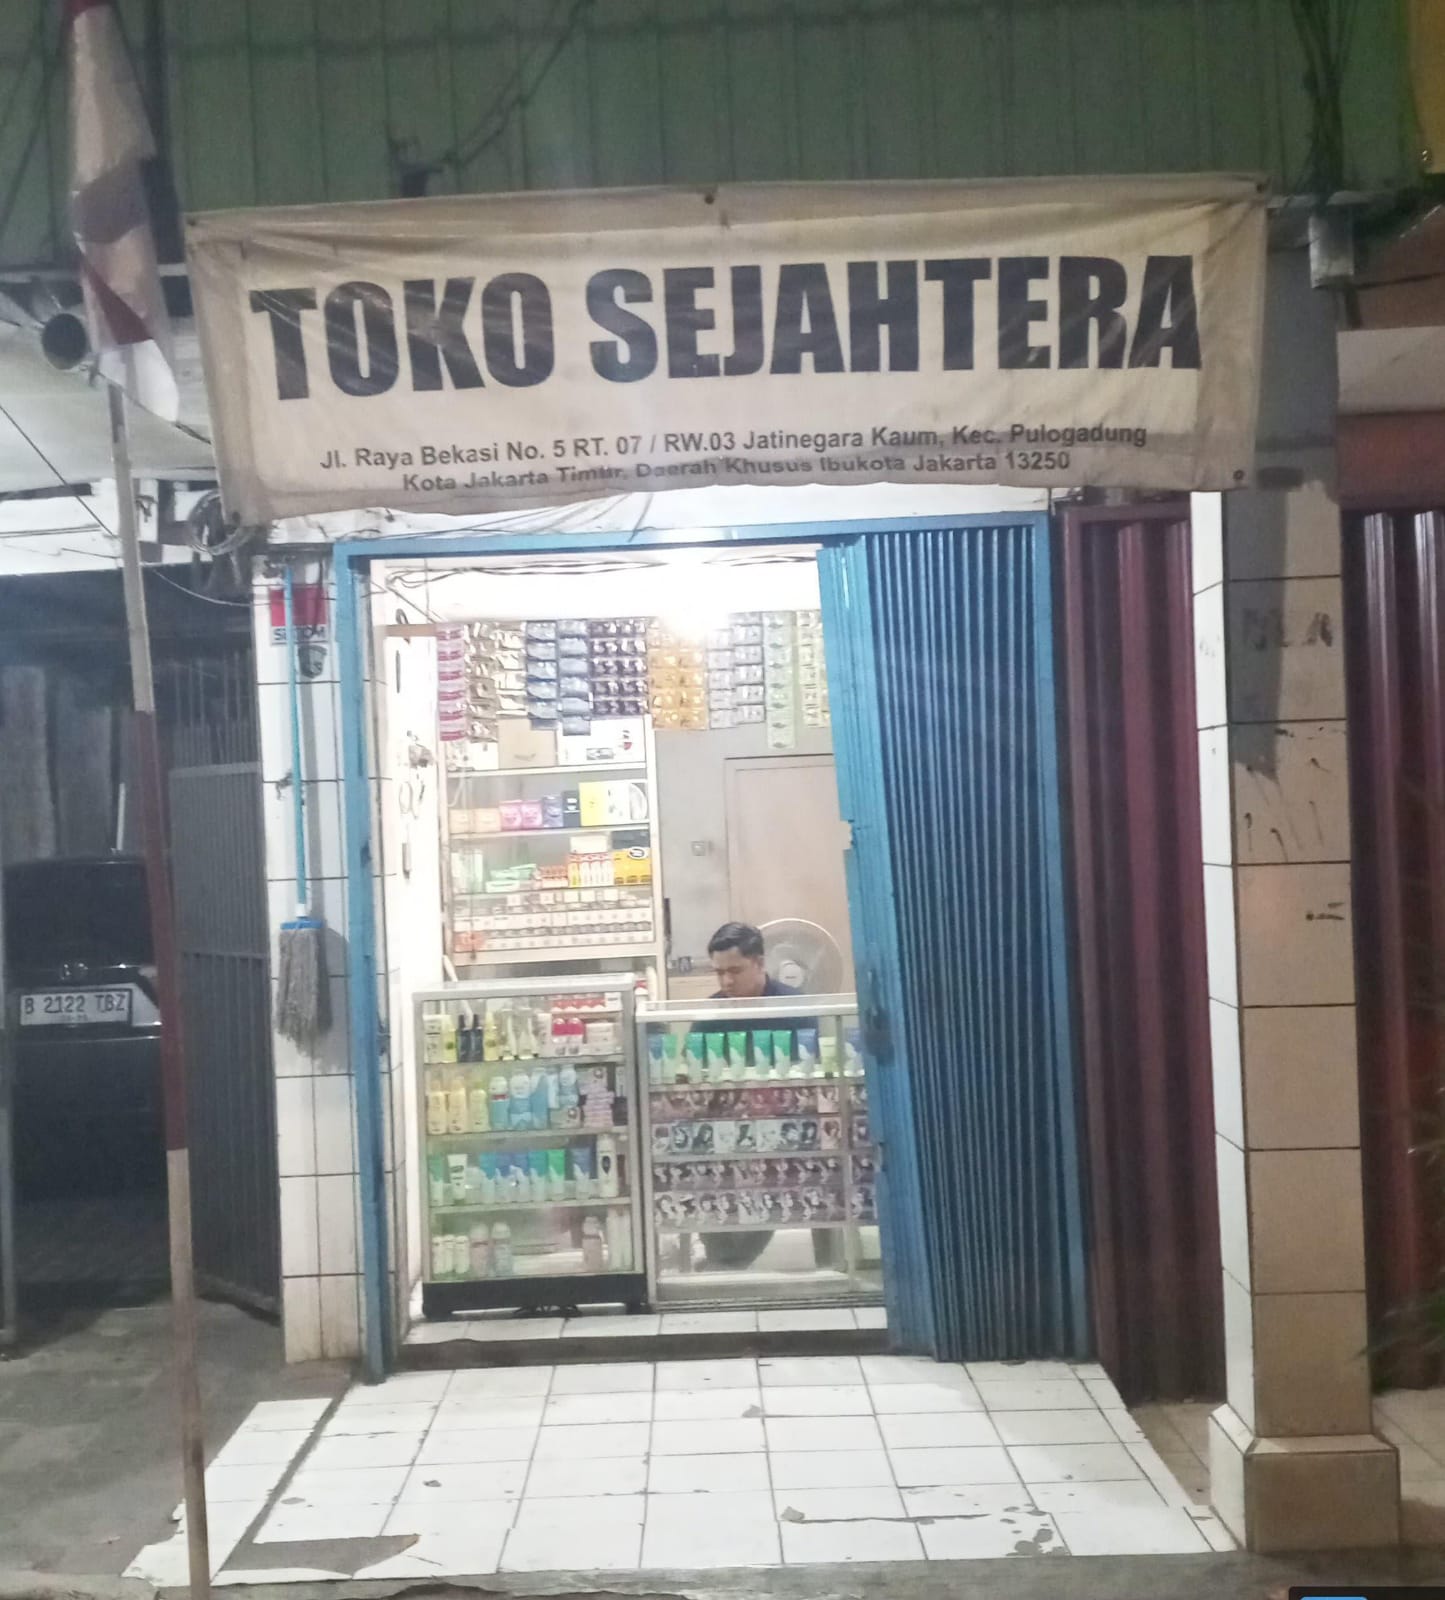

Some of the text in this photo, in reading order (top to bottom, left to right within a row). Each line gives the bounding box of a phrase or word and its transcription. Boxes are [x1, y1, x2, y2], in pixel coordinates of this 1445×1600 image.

[248, 255, 1202, 401] TOKO SEJAHTERA
[320, 424, 1147, 470] Jl. Raya Bekasi No. 5 RT. 07 / RW.03 Jatinegara Kaum, Kec. Pulogadung
[403, 473, 457, 492] Kota
[464, 470, 549, 489] Jakarta
[636, 461, 717, 478] Daerah
[725, 457, 812, 473] Khusus
[821, 456, 906, 472] Ibukota
[913, 453, 997, 472] Jakarta
[1005, 451, 1071, 471] 13250
[25, 997, 34, 1014] B
[43, 995, 86, 1013] 2122
